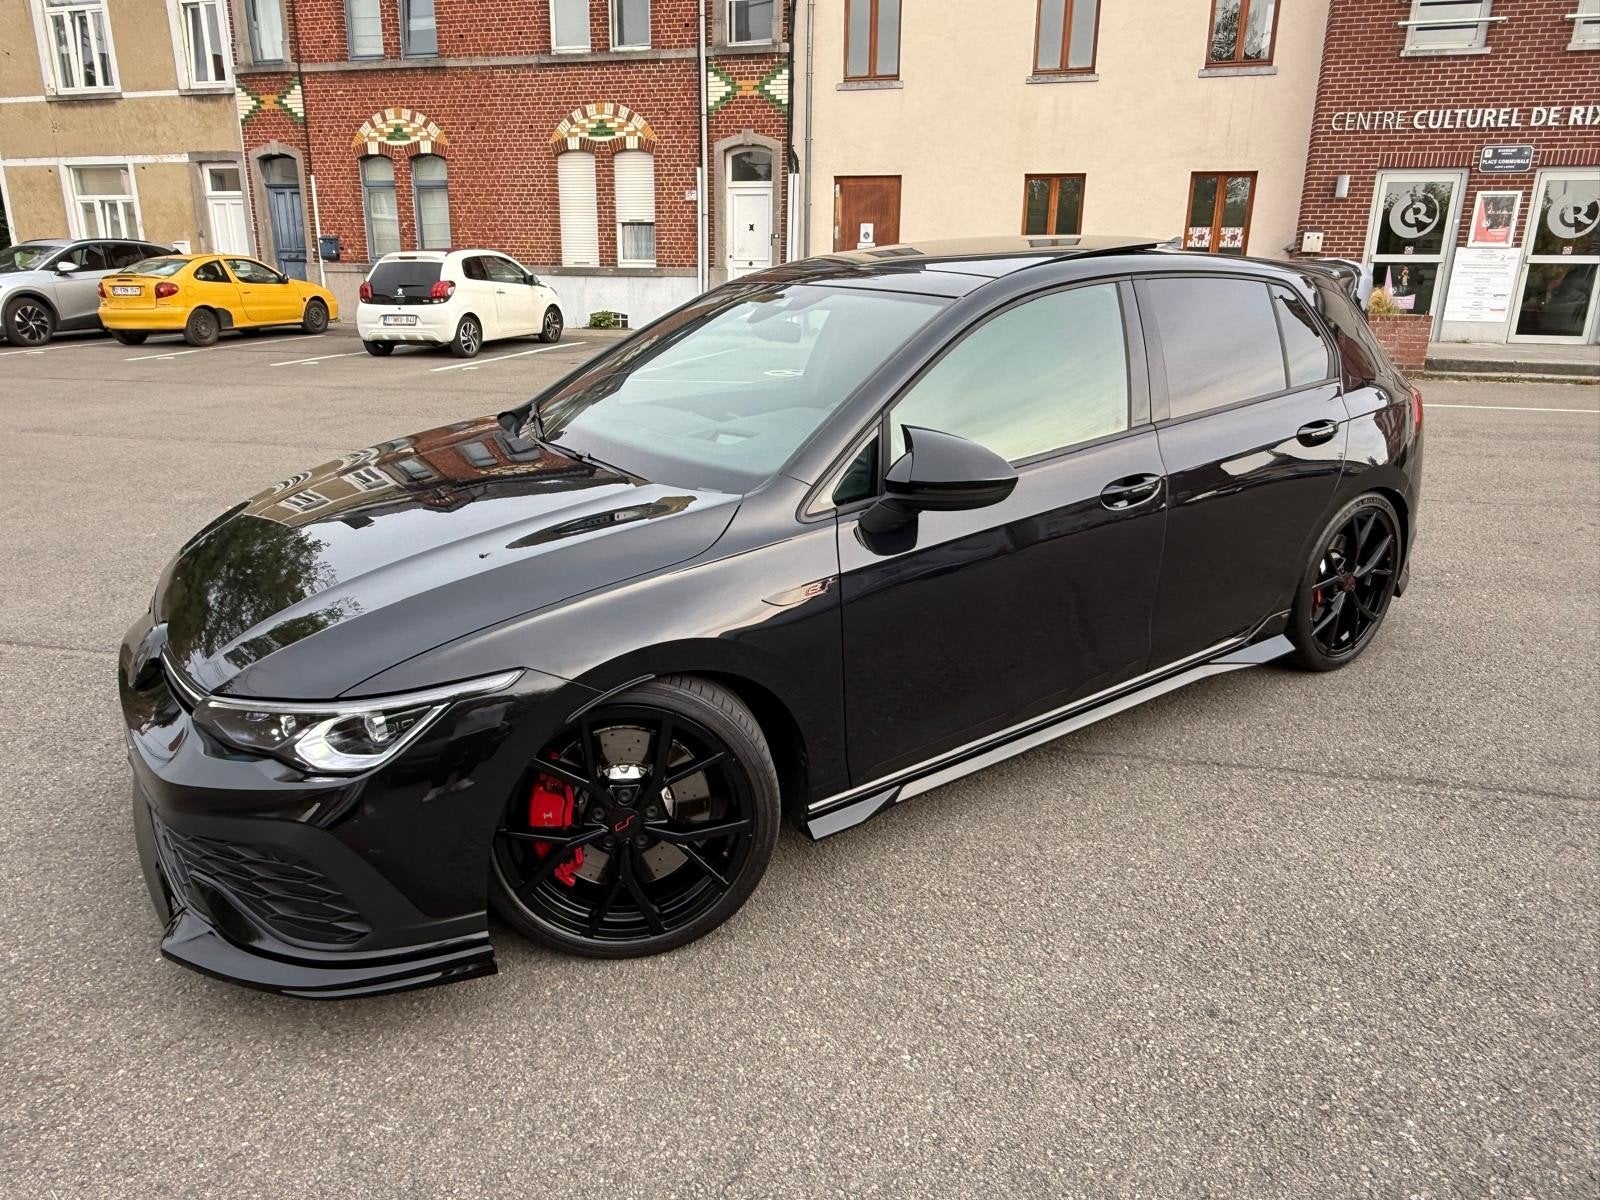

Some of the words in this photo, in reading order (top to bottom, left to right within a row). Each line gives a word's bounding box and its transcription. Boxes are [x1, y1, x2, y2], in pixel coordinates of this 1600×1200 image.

[1331, 111, 1407, 131] CENTRE
[1413, 107, 1521, 129] CULTUREL
[1530, 106, 1562, 126] DE
